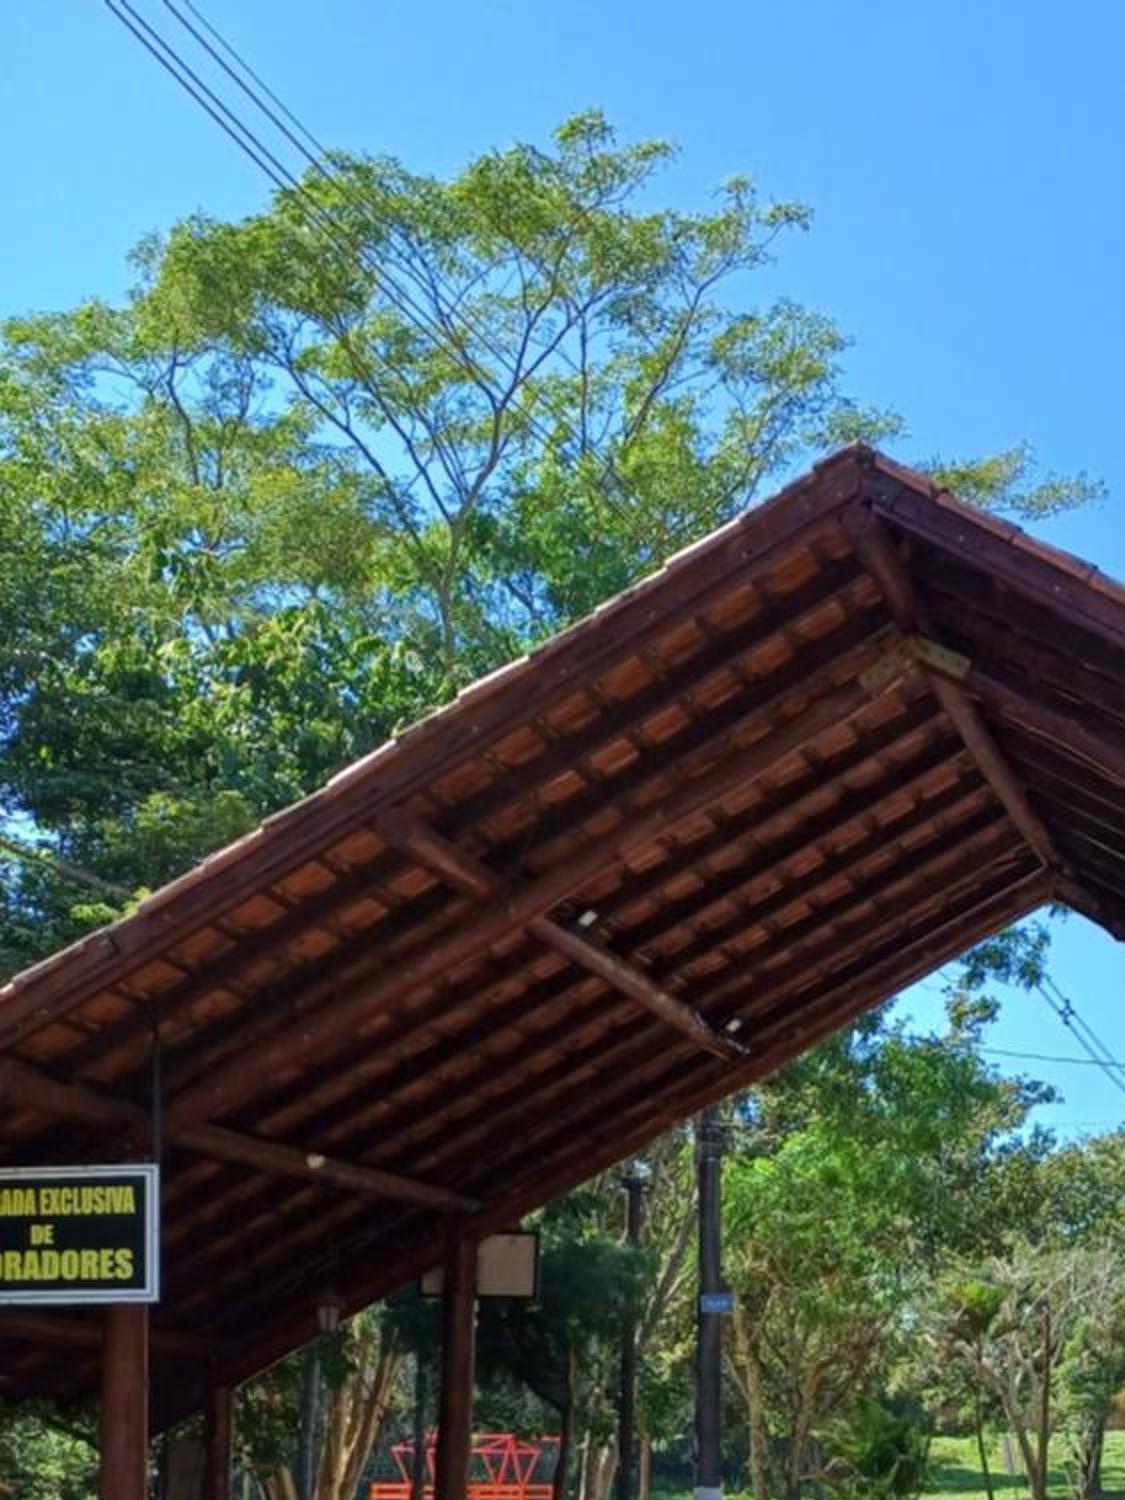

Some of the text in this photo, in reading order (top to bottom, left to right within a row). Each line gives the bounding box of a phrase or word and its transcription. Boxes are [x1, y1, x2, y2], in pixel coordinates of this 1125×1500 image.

[0, 1186, 136, 1216] ADA EXCLUSIVA
[30, 1223, 55, 1245] DE
[0, 1248, 134, 1281] RADORES
